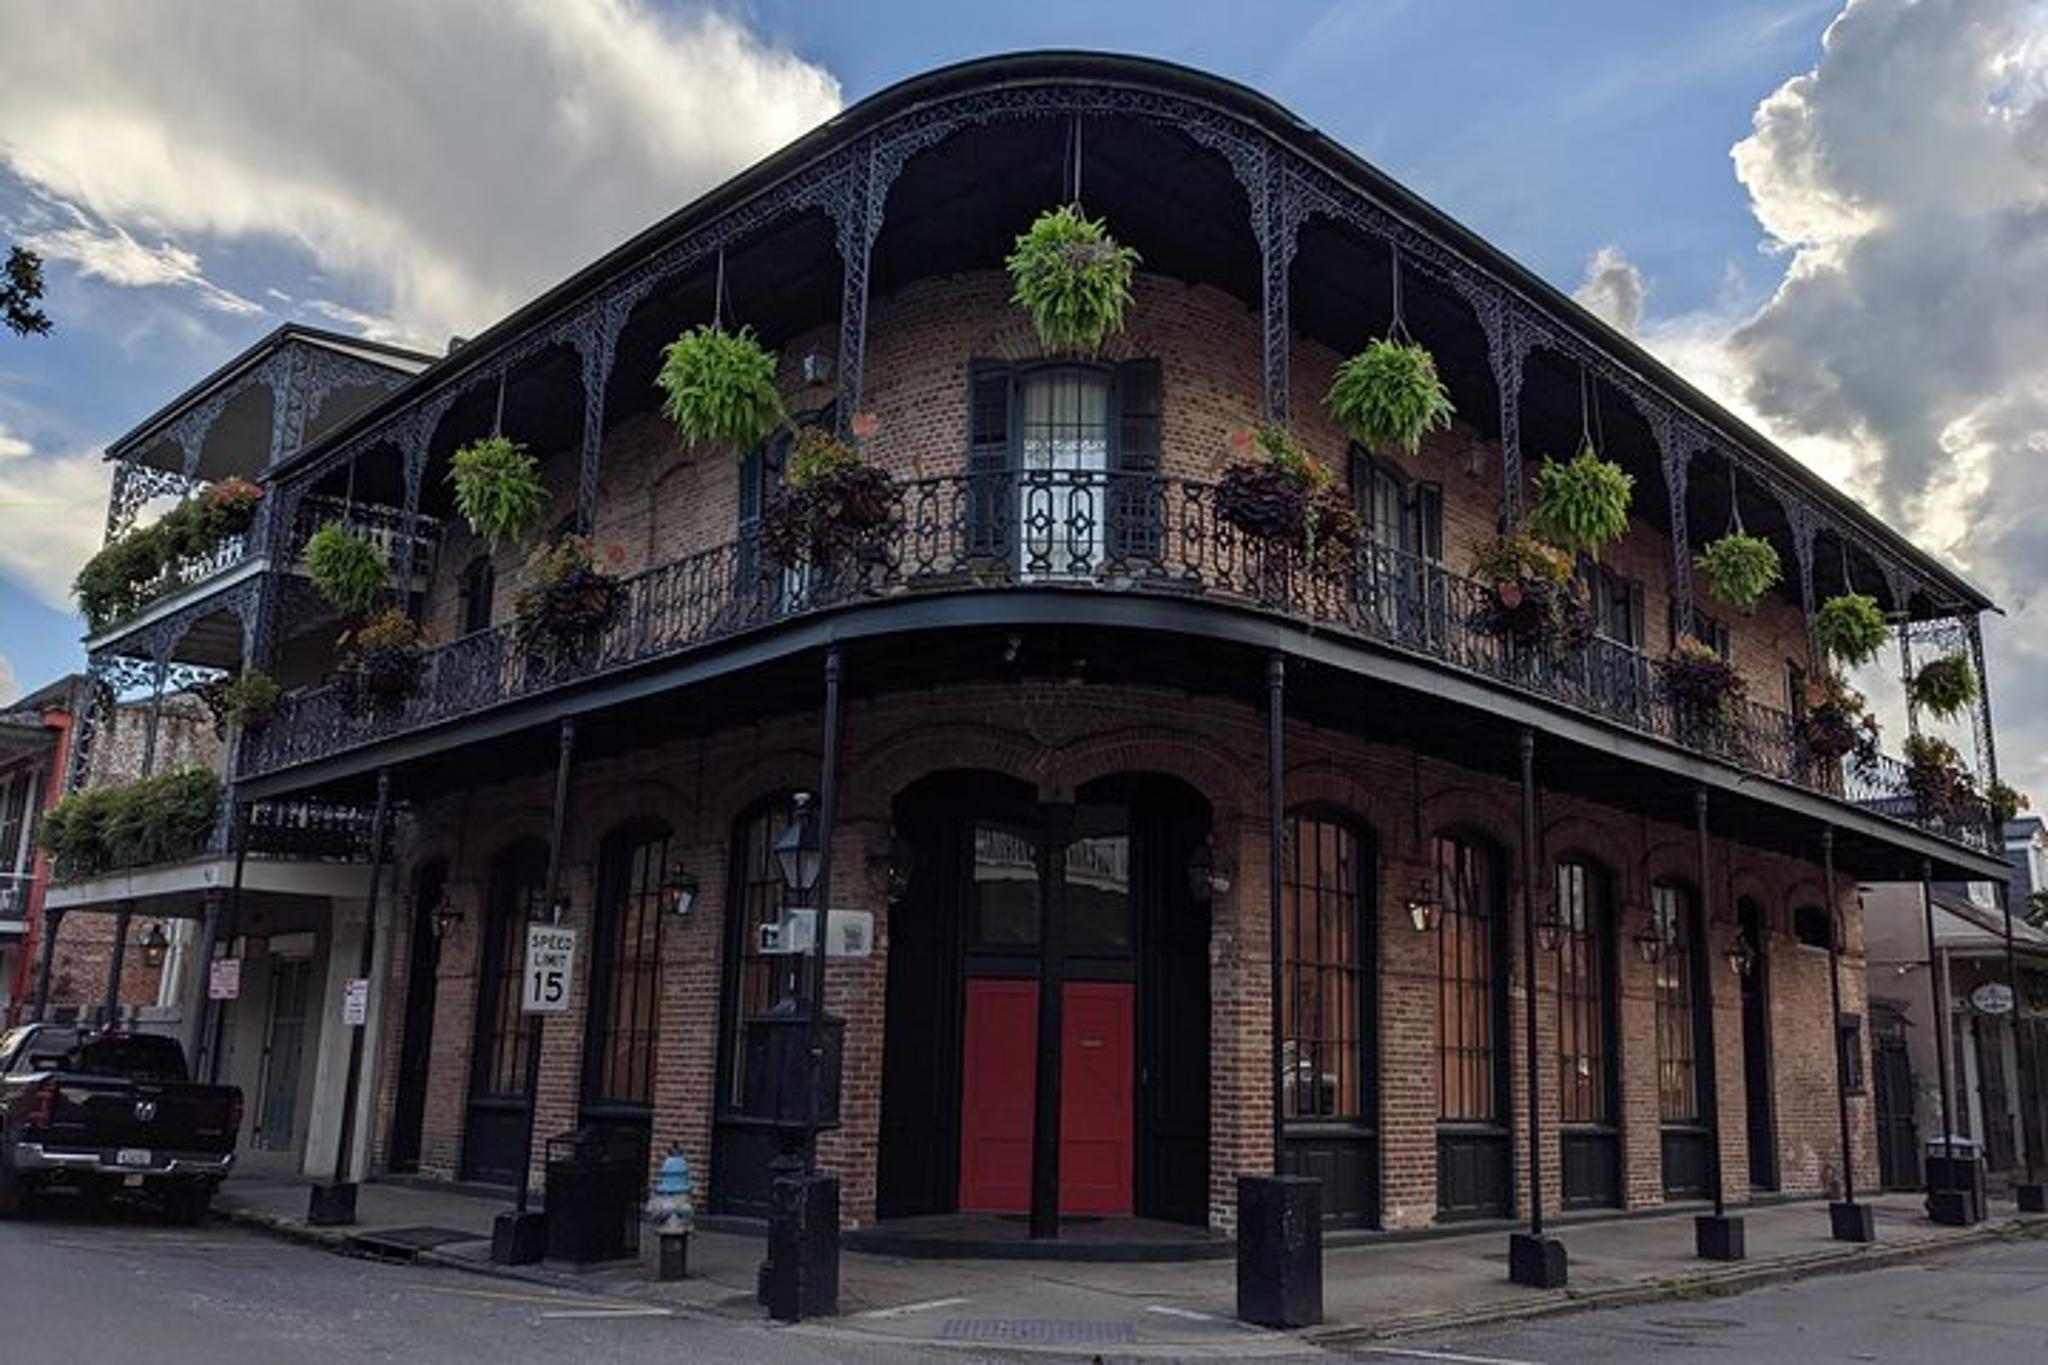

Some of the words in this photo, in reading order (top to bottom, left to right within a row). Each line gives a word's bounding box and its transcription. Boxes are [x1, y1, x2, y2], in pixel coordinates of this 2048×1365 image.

[532, 933, 574, 950] SPEED
[534, 952, 567, 967] LIMIT
[534, 971, 563, 1002] 15
